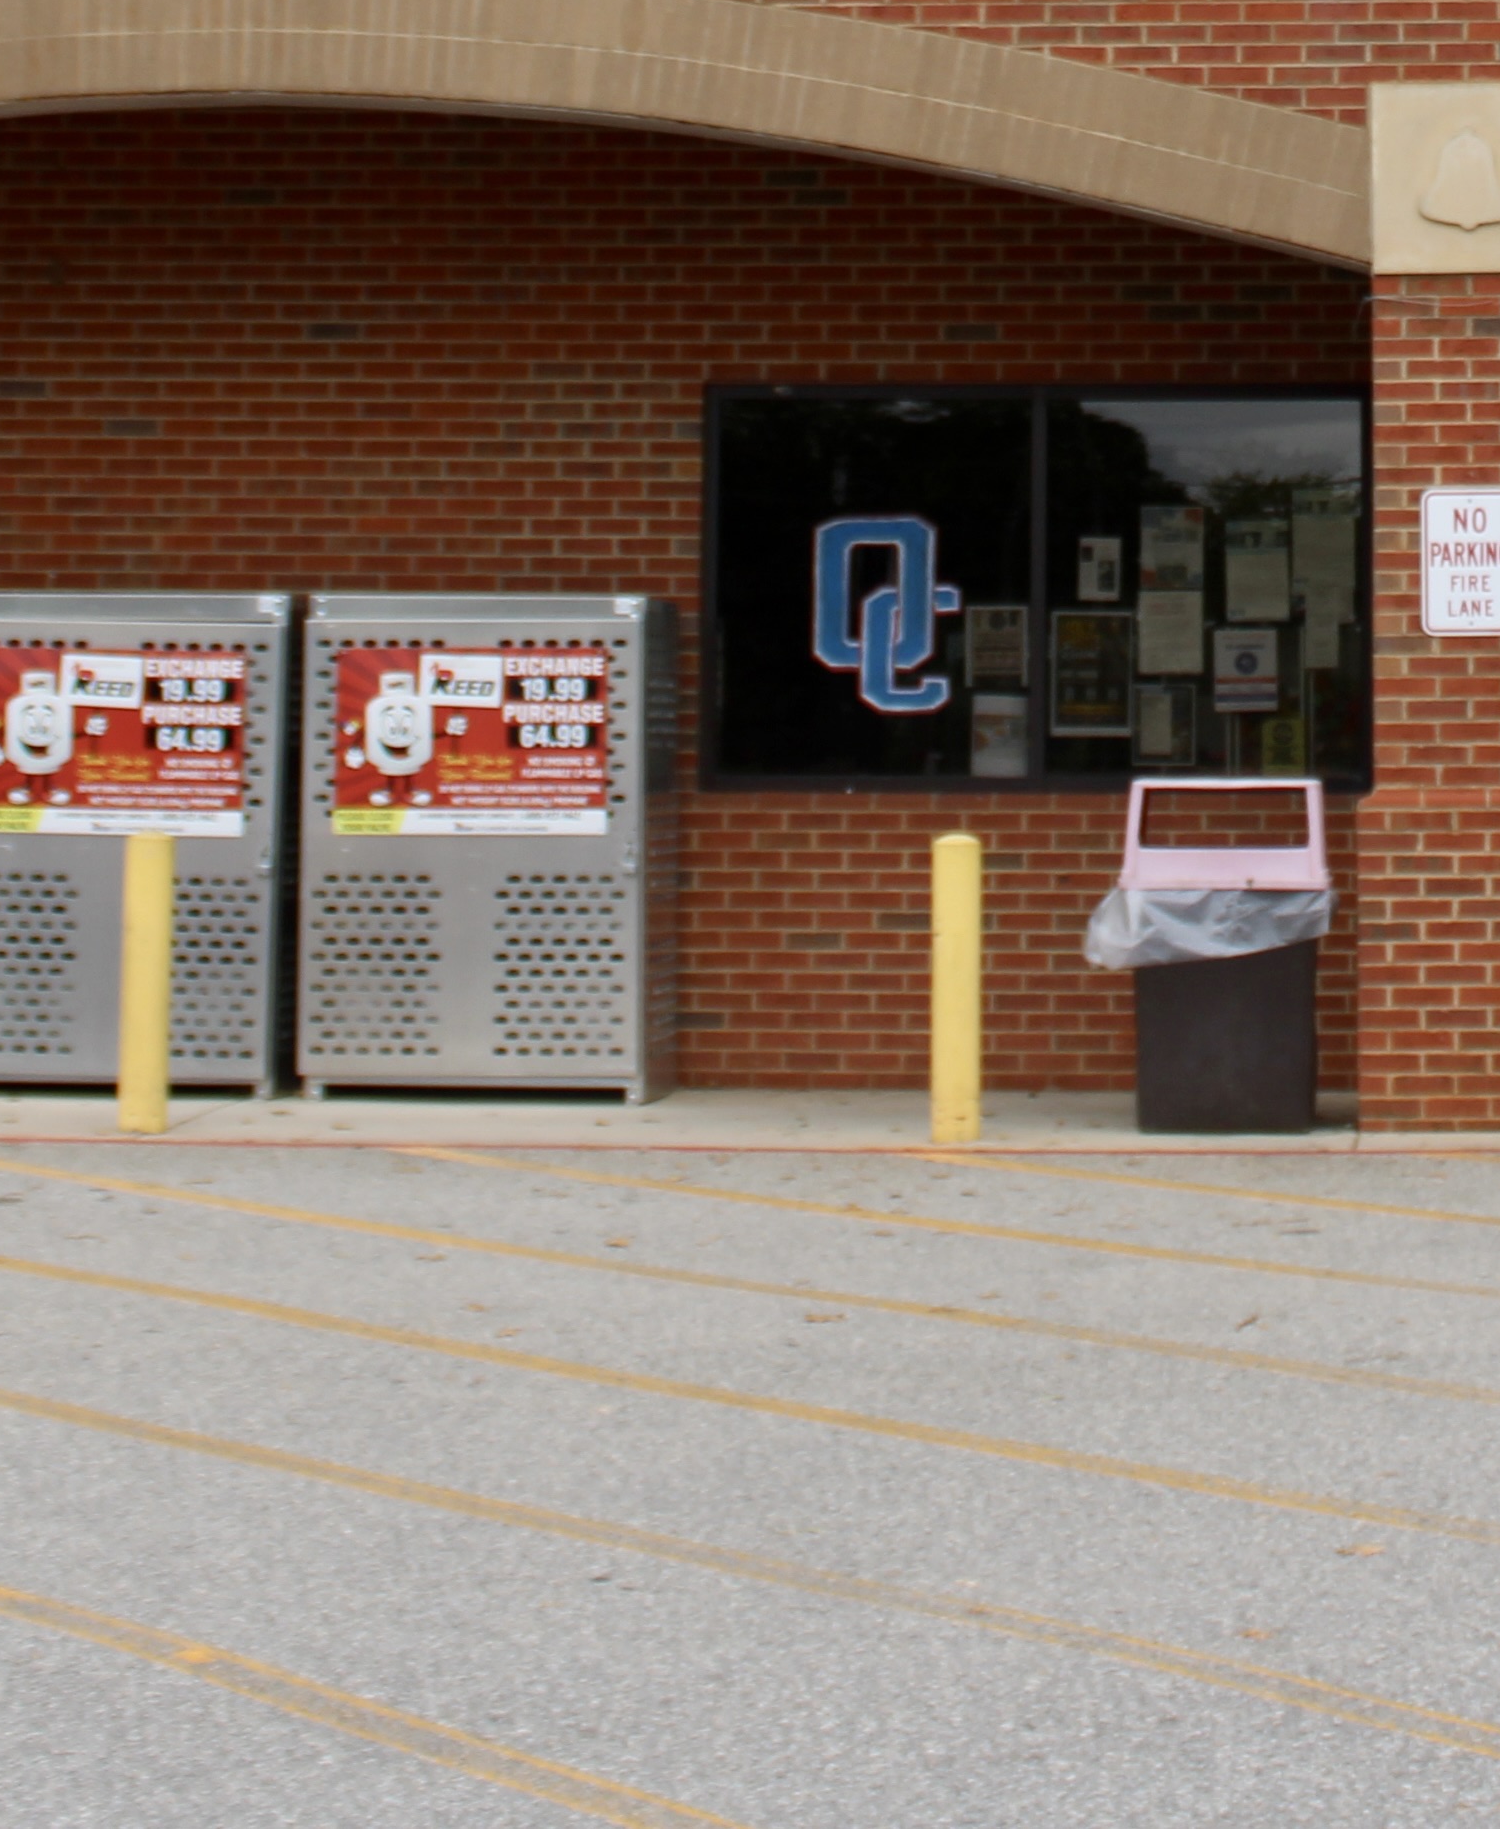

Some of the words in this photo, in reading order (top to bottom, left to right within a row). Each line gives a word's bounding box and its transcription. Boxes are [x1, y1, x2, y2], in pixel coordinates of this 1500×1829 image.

[1452, 507, 1488, 534] NO
[1450, 574, 1492, 593] FIRE
[1447, 599, 1495, 618] LANE
[144, 659, 245, 679] EXCHANGE
[504, 657, 605, 676] EXCHANGE
[159, 679, 226, 703] 19.99
[520, 678, 588, 702] 19.99
[141, 704, 243, 725] PURCHASE
[502, 703, 605, 723] PURCHASE
[155, 727, 226, 752] 64.99
[518, 725, 588, 749] 64.99
